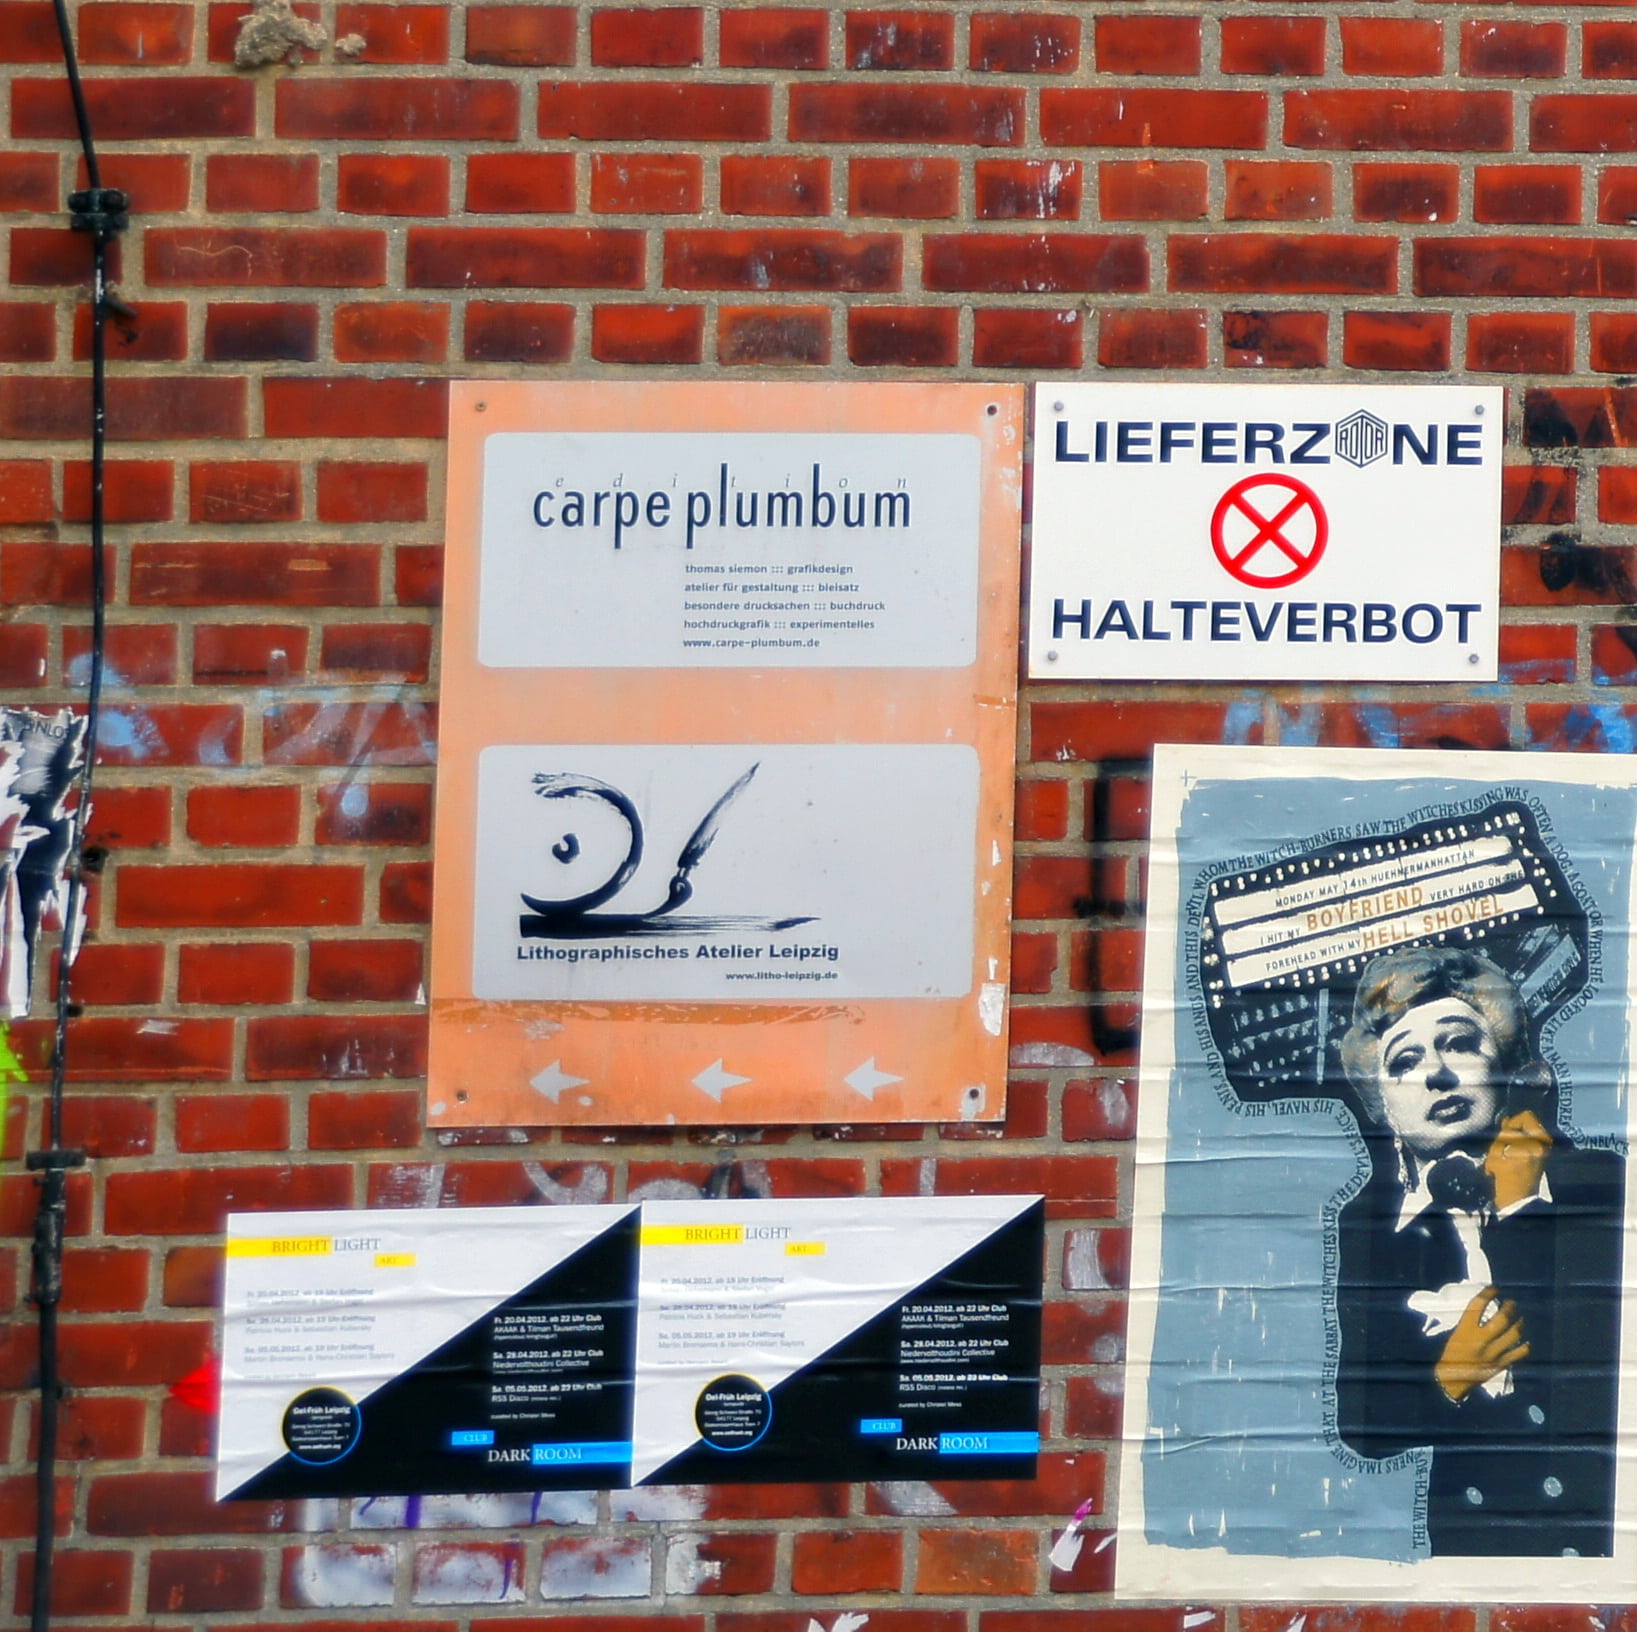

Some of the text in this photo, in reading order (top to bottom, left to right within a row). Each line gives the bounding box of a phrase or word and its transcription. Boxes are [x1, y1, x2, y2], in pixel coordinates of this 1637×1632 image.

[533, 463, 911, 549] carpe plumbum
[685, 563, 853, 575] thomas siemon grafikdesign
[684, 582, 860, 594] atelier für gestaltung bleisatz
[684, 601, 885, 611] besondere drucksachen buchdruck
[683, 619, 875, 630] hochdruckgrafik experimentelles
[1052, 598, 1482, 644] HALTEVERBOT
[683, 638, 820, 649] www.carpe-plumbum.de
[1355, 821, 1385, 837] SAW
[1384, 818, 1406, 834] THE
[1407, 803, 1460, 825] WITCHES
[1504, 786, 1529, 801] WAS
[1275, 892, 1314, 908] MONDAY
[1319, 884, 1339, 897] MAY
[1267, 932, 1283, 945] HIT
[1287, 928, 1301, 939] MY
[1307, 886, 1423, 931] BOYFRIEND
[1429, 888, 1455, 902] VERY
[1458, 881, 1484, 896] HARD
[1266, 951, 1316, 971] FOREHEAD
[1320, 942, 1345, 958] WITH
[1363, 921, 1413, 949] HELL
[1424, 896, 1504, 933] SHOVEL
[517, 944, 839, 963] Lithographisches Atelier Leipzig
[725, 970, 838, 981] www.litho-leipzig.de
[685, 1226, 791, 1241] BRIGHT LIGHT
[272, 1238, 381, 1253] BRIGHT LIGHT
[896, 1436, 988, 1451] DARK ROOM
[488, 1447, 582, 1463] DARK ROOM
